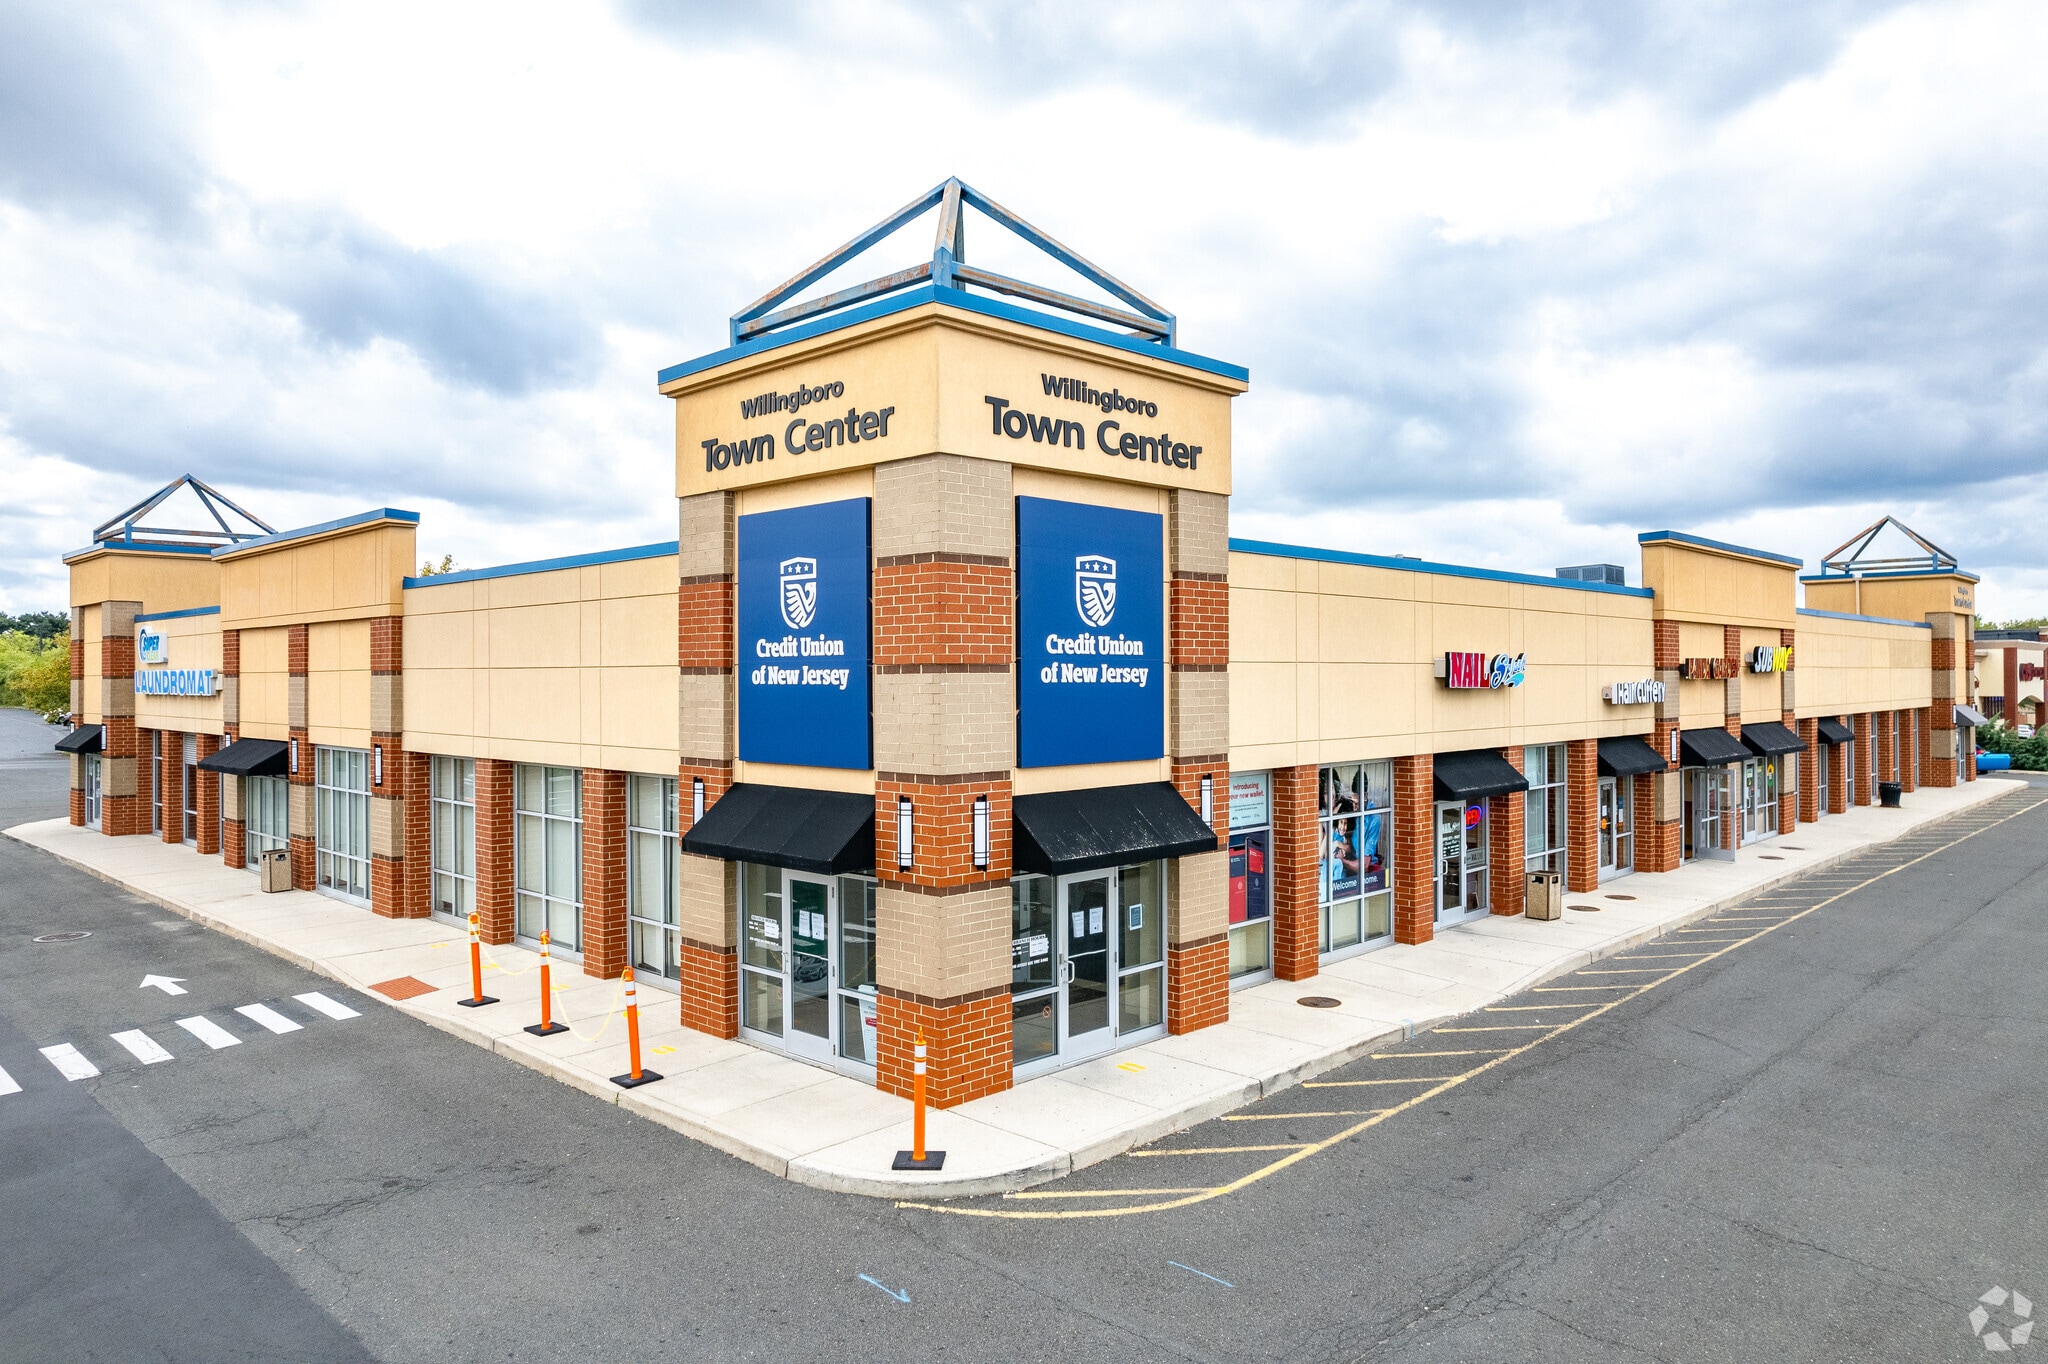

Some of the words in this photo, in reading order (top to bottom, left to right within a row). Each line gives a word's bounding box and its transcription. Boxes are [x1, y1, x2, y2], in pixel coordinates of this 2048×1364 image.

[740, 381, 844, 419] Willingboro
[1041, 373, 1158, 418] Willingboro
[701, 433, 775, 472] Town
[784, 406, 895, 455] Center
[985, 395, 1085, 450] Town
[1096, 420, 1203, 470] Center
[756, 635, 798, 657] Credit
[800, 633, 845, 656] Union
[1045, 632, 1096, 655] Credit
[1097, 633, 1144, 656] Union
[1449, 652, 1490, 688] NAIL
[1688, 658, 1711, 680] PANDA
[1754, 646, 1793, 674] SUBWAY
[134, 670, 212, 696] LAUNDROMAT
[751, 665, 767, 685] of
[767, 666, 800, 685] New
[801, 665, 850, 691] Jersey
[1040, 662, 1059, 684] of
[1060, 663, 1098, 683] New
[1100, 664, 1149, 688] Jersey
